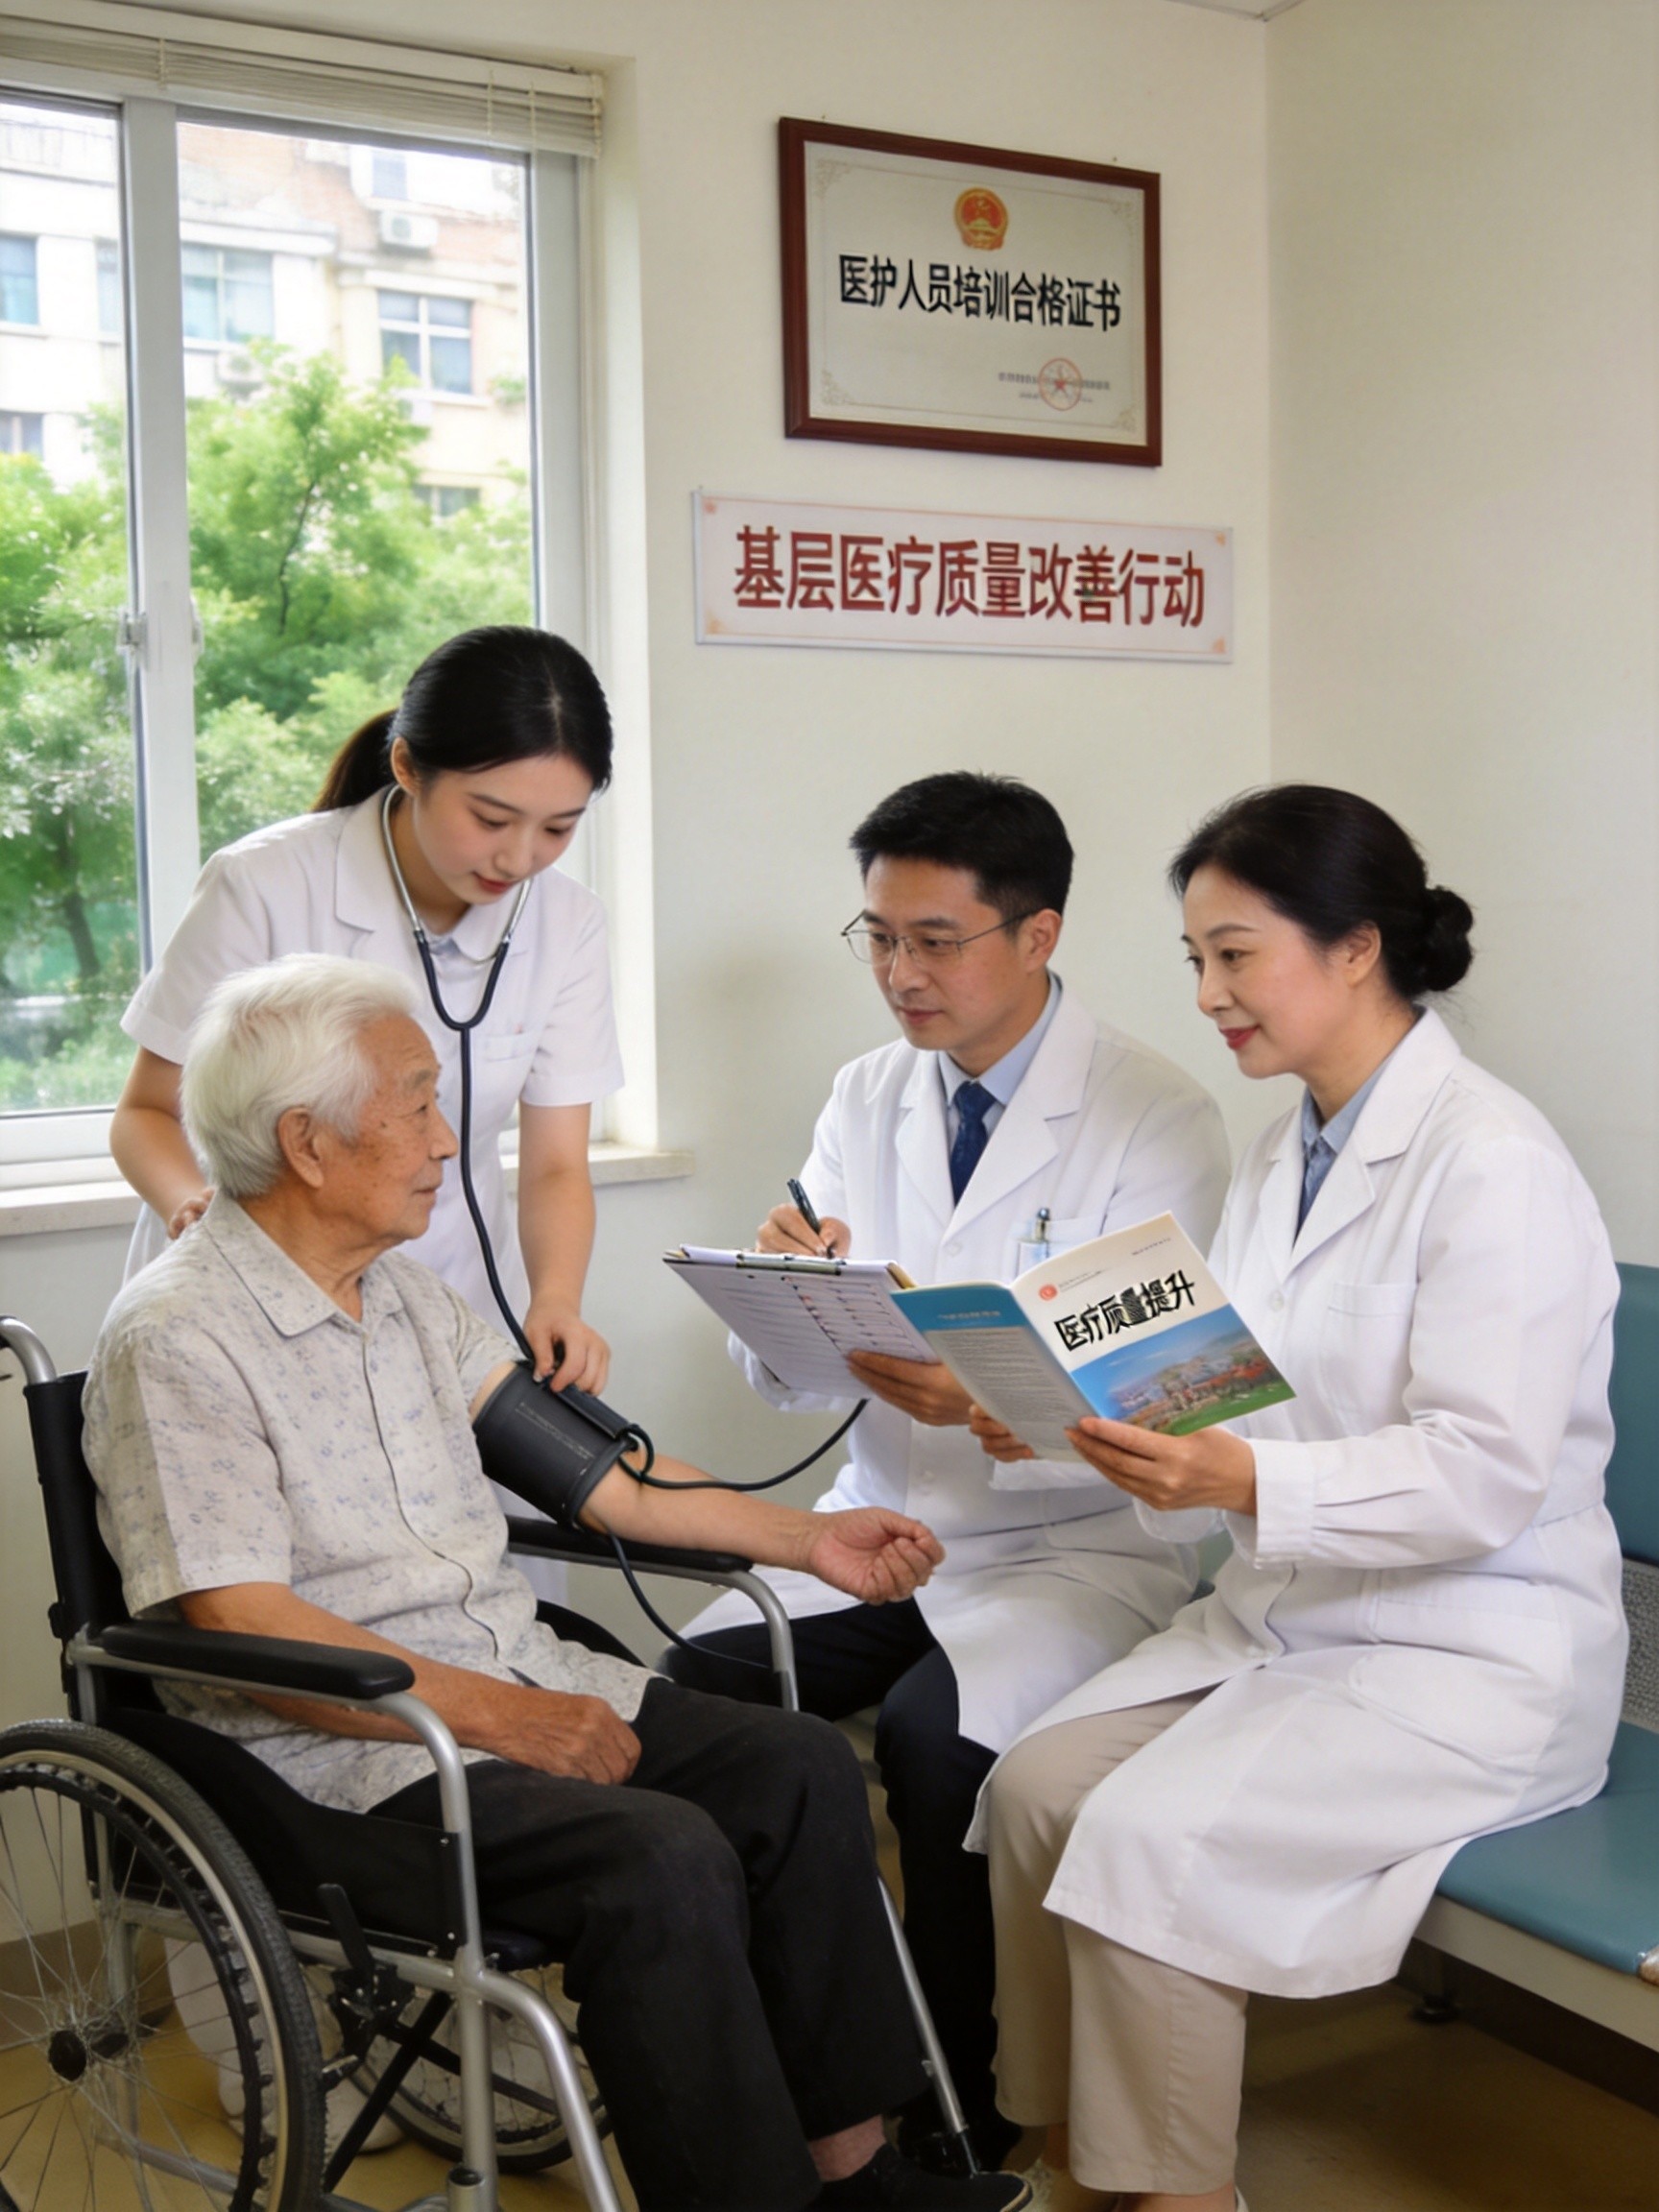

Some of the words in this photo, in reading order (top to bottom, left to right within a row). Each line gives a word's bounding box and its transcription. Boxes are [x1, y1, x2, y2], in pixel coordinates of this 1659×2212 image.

[839, 254, 1120, 331] 医护人员培训合格证书
[734, 525, 1204, 627] 基层医疗质量改善行动
[1054, 1270, 1194, 1352] 医疗质提升
